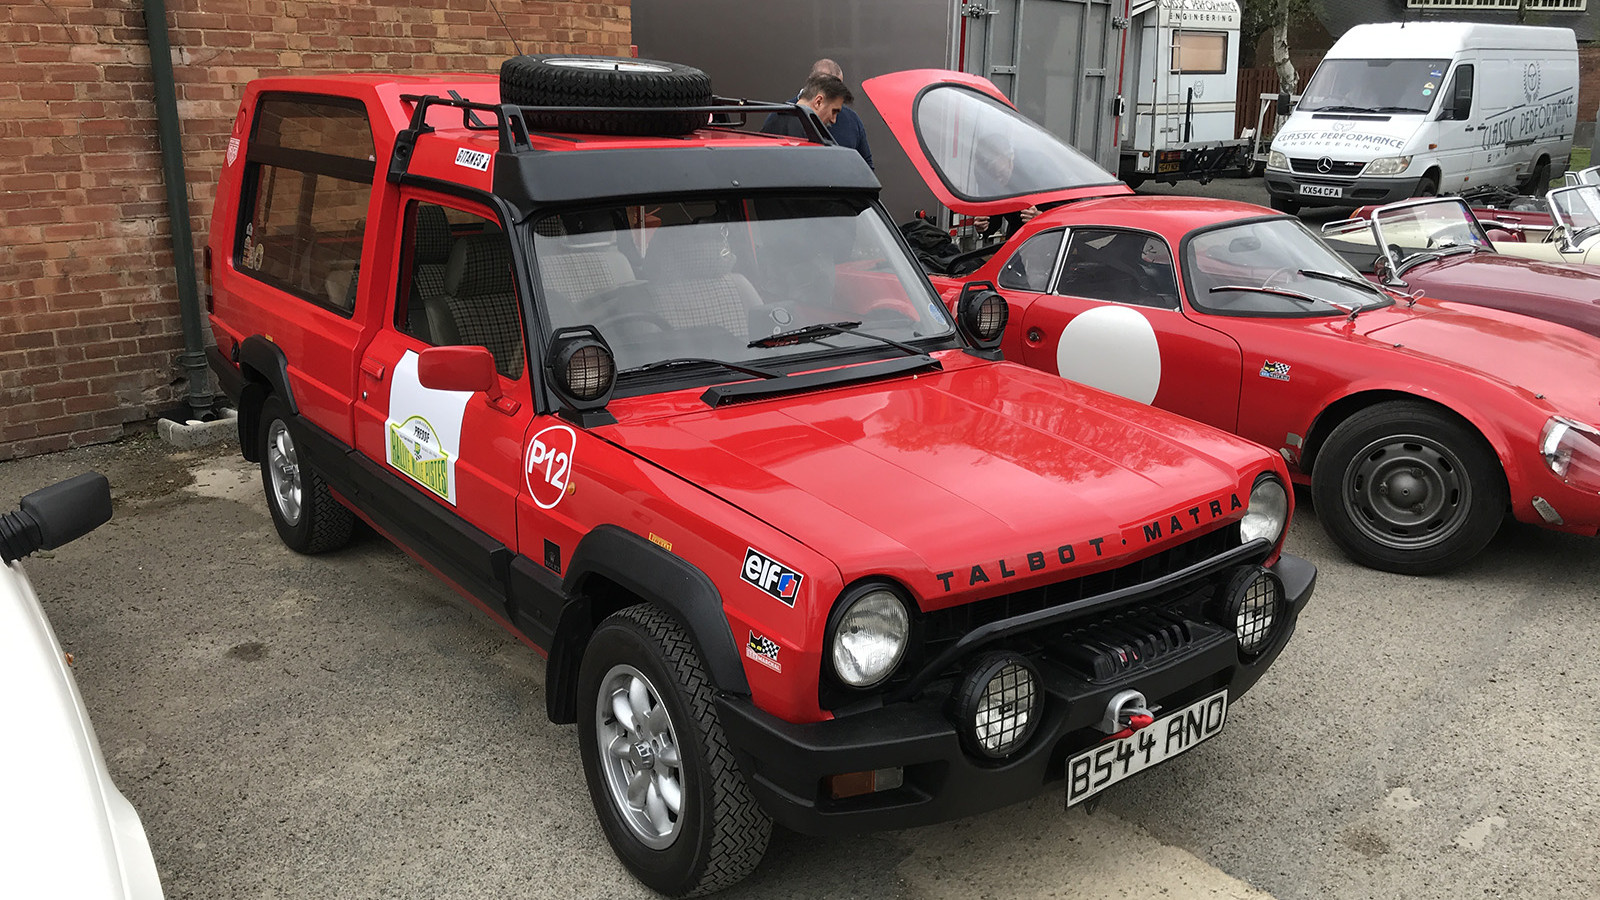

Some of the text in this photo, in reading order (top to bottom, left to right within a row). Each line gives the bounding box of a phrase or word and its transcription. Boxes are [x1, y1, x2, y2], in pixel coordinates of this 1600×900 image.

[1169, 13, 1233, 22] ENGINEERING
[1277, 132, 1405, 149] CLASSIC PERFORMANCE
[1282, 140, 1381, 151] ENGINEERING
[1481, 117, 1516, 151] CLASSIC
[456, 149, 485, 167] GITANES
[1302, 185, 1340, 196] KX54 CFA
[528, 439, 568, 490] P12
[936, 493, 1243, 592] TALBOT MATRA
[745, 554, 781, 591] elf
[1071, 731, 1157, 801] B544
